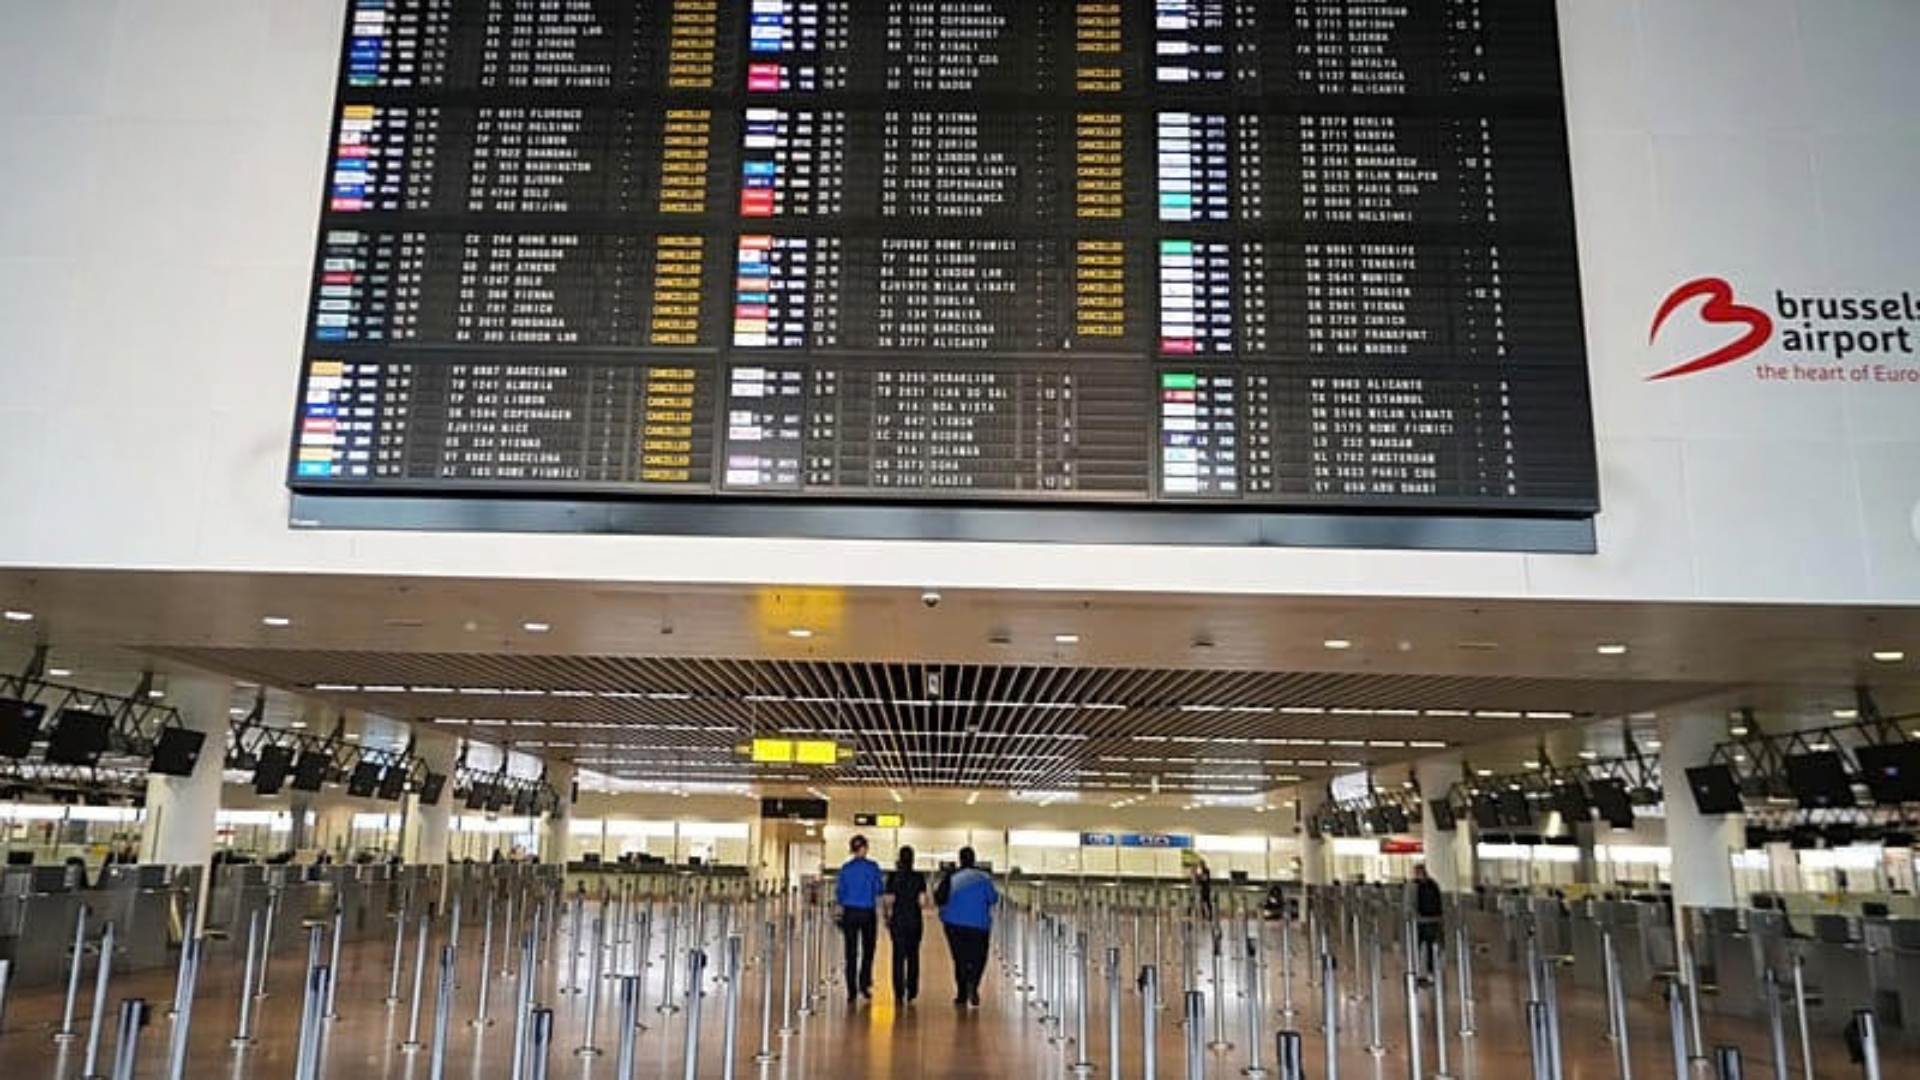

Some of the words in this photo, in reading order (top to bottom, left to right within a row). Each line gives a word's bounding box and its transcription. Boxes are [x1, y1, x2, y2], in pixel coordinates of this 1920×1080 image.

[1776, 290, 1920, 320] brussel
[1783, 323, 1912, 358] airport
[1757, 365, 1787, 379] the
[1794, 364, 1844, 380] heart
[1850, 364, 1869, 381] of
